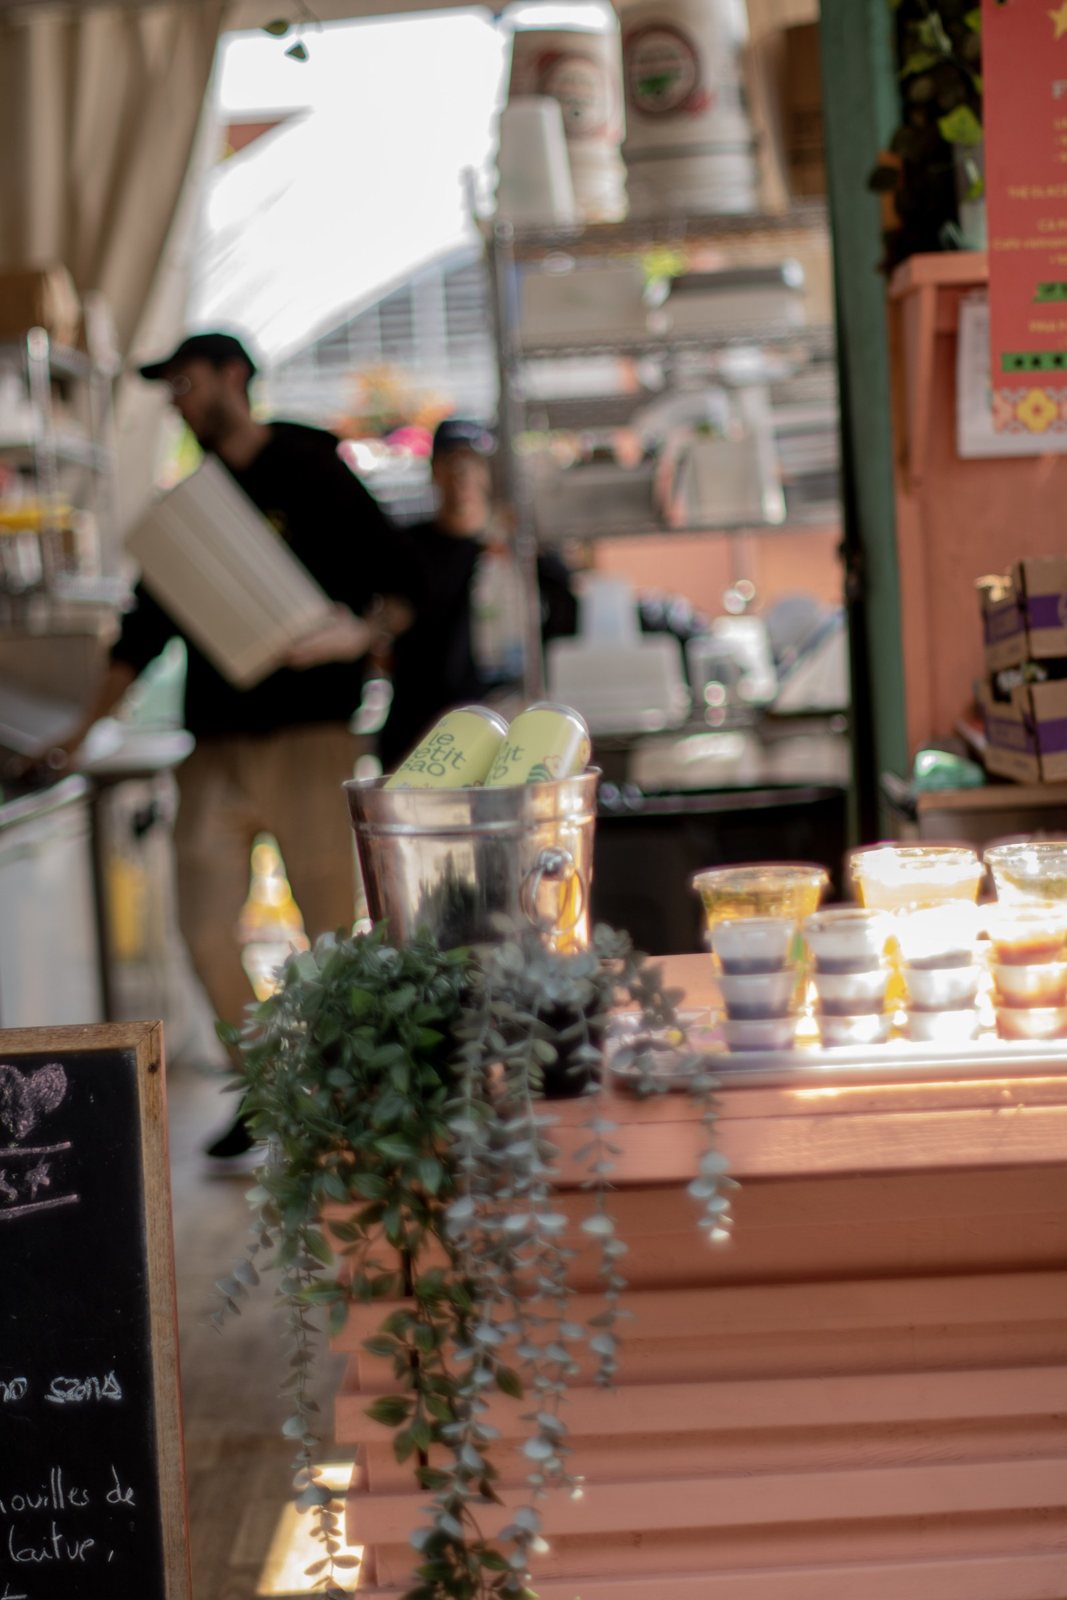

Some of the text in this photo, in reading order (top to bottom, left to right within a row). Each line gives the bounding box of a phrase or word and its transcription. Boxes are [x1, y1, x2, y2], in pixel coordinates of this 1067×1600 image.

[412, 746, 467, 770] etit
[0, 1464, 136, 1513] ouilles de
